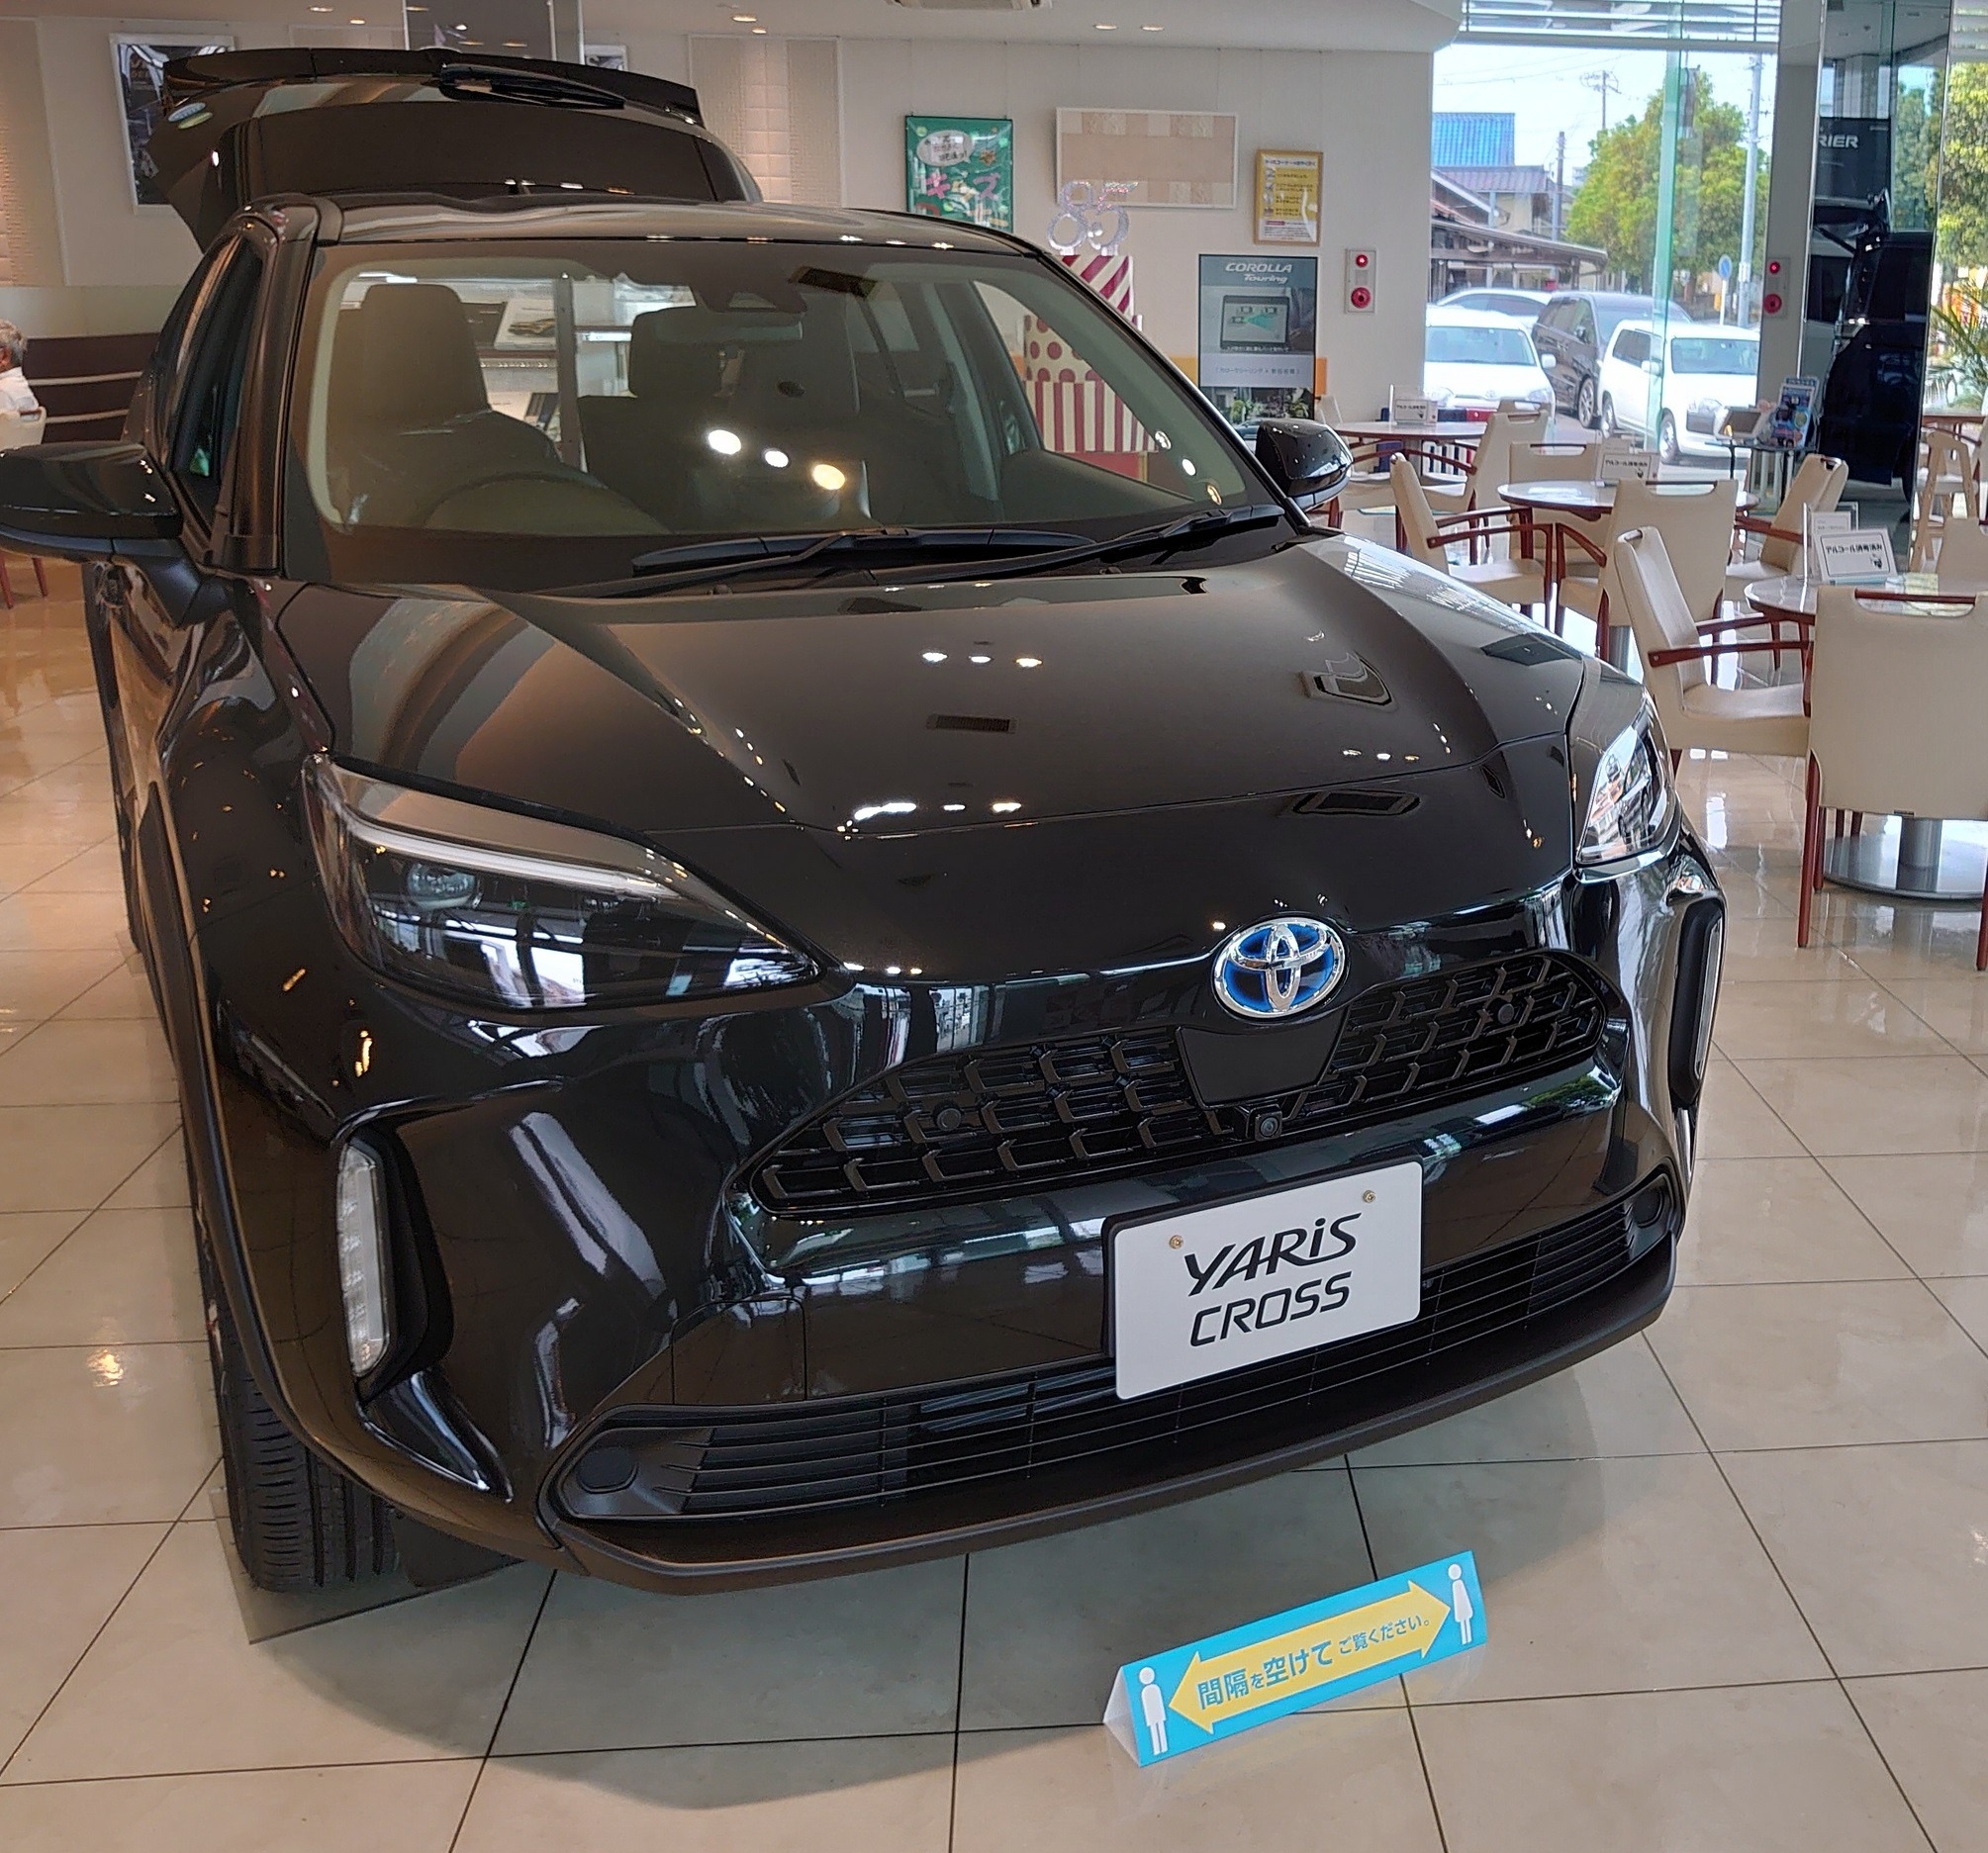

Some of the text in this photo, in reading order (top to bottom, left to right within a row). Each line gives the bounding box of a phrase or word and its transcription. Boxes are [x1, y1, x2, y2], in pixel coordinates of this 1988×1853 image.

[1047, 180, 1138, 249] 85
[1225, 262, 1292, 273] COROLLA
[1244, 274, 1287, 284] Touring
[1189, 1270, 1352, 1346] CROSS
